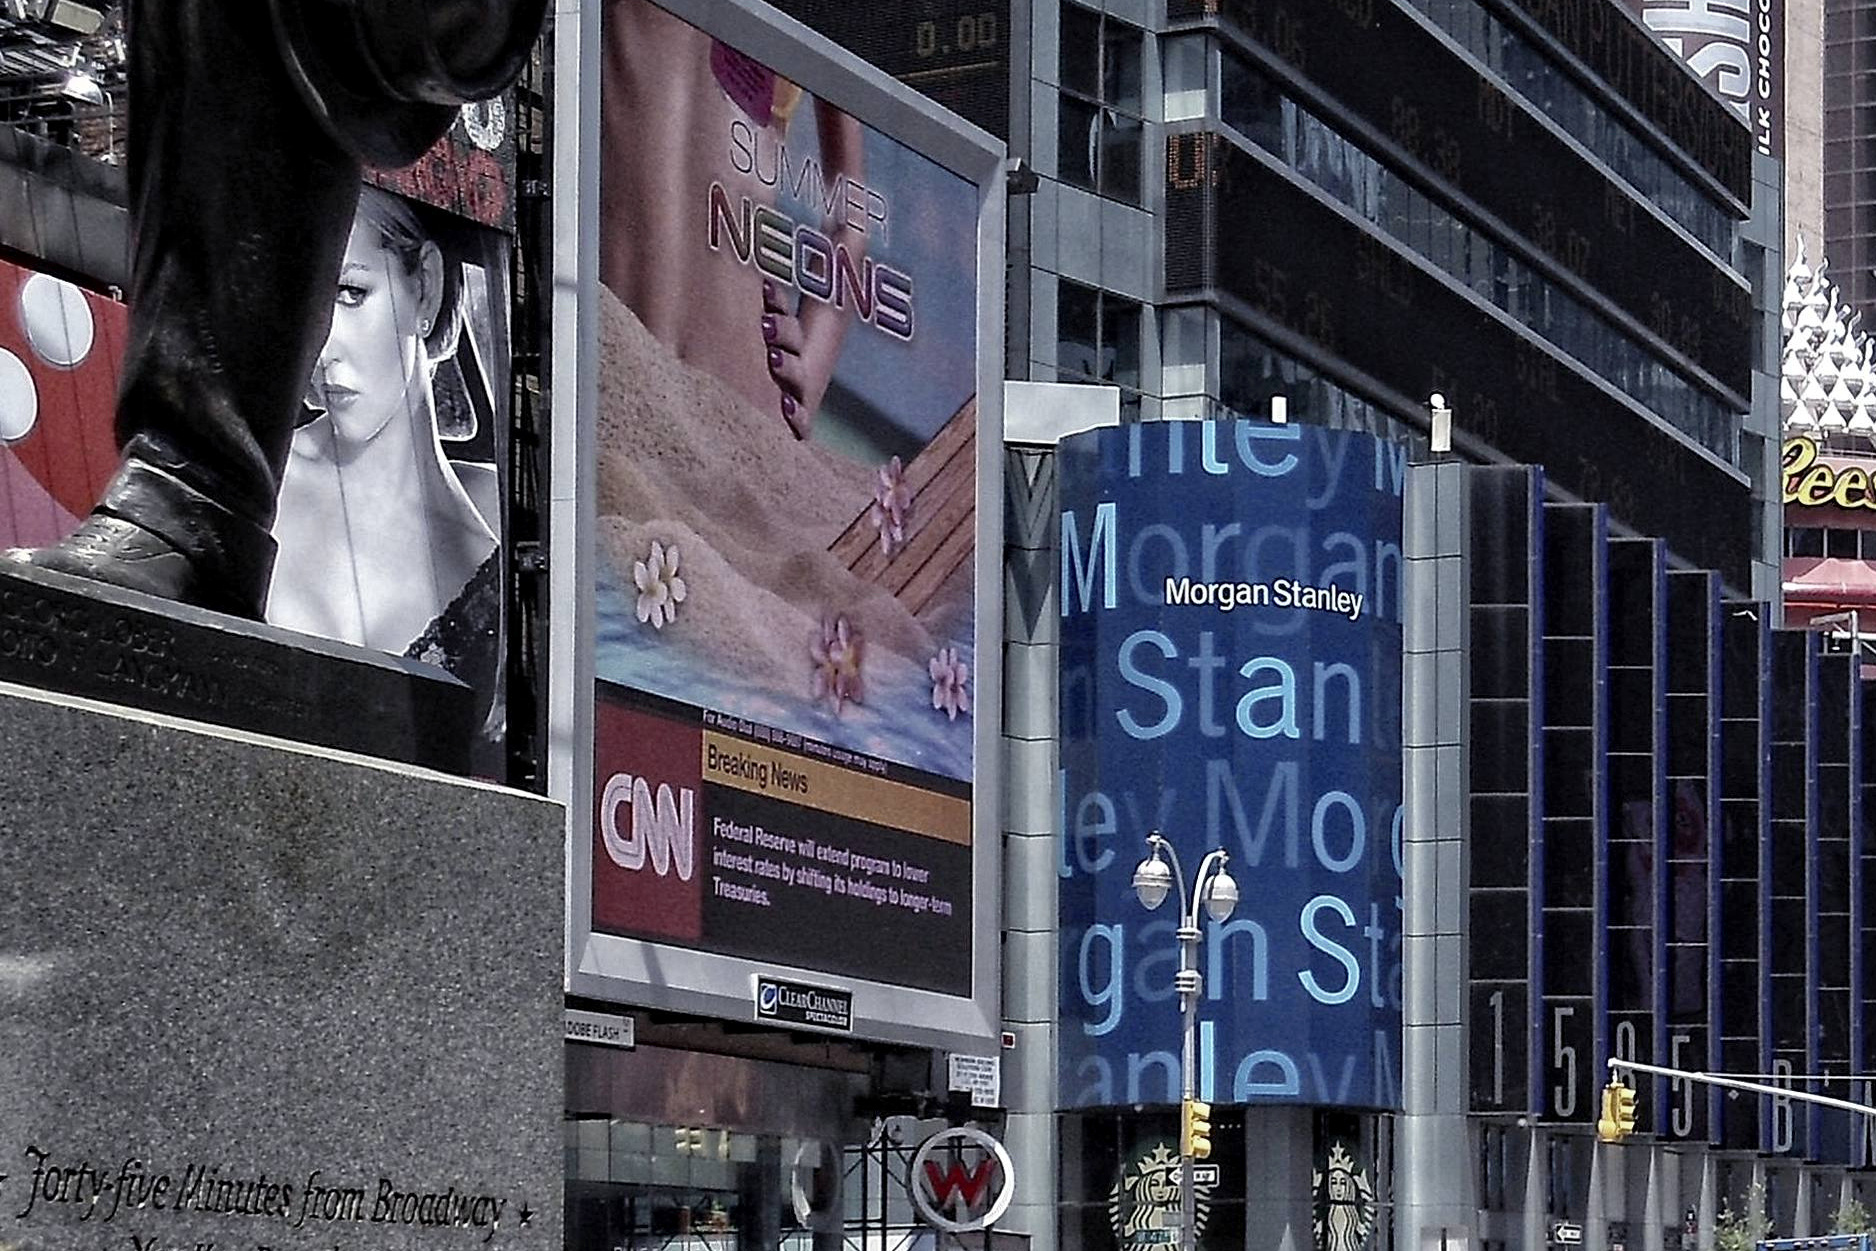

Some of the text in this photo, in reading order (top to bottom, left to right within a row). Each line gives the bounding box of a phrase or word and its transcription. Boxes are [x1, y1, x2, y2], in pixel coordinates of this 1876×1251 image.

[730, 119, 889, 248] SUMMER
[708, 181, 914, 342] NEONS
[1165, 575, 1365, 620] Morgan Stanley
[707, 743, 768, 790] Breaking
[771, 760, 808, 794] News
[600, 772, 695, 881] CNN
[713, 816, 754, 844] Federal
[755, 826, 797, 854] Reserve
[797, 838, 815, 859] will
[816, 845, 849, 866] extend
[850, 853, 890, 876] program
[891, 859, 902, 878] to
[713, 845, 753, 874] interest
[754, 858, 780, 880] rates
[782, 861, 796, 887] by
[796, 866, 832, 895] shifting
[847, 876, 888, 906] holdings
[888, 886, 900, 905] to
[592, 1023, 620, 1040] FLASH
[173, 1164, 293, 1218] Minutes
[293, 1170, 366, 1229] from
[371, 1178, 508, 1243] Broadway
[923, 1159, 998, 1210] W
